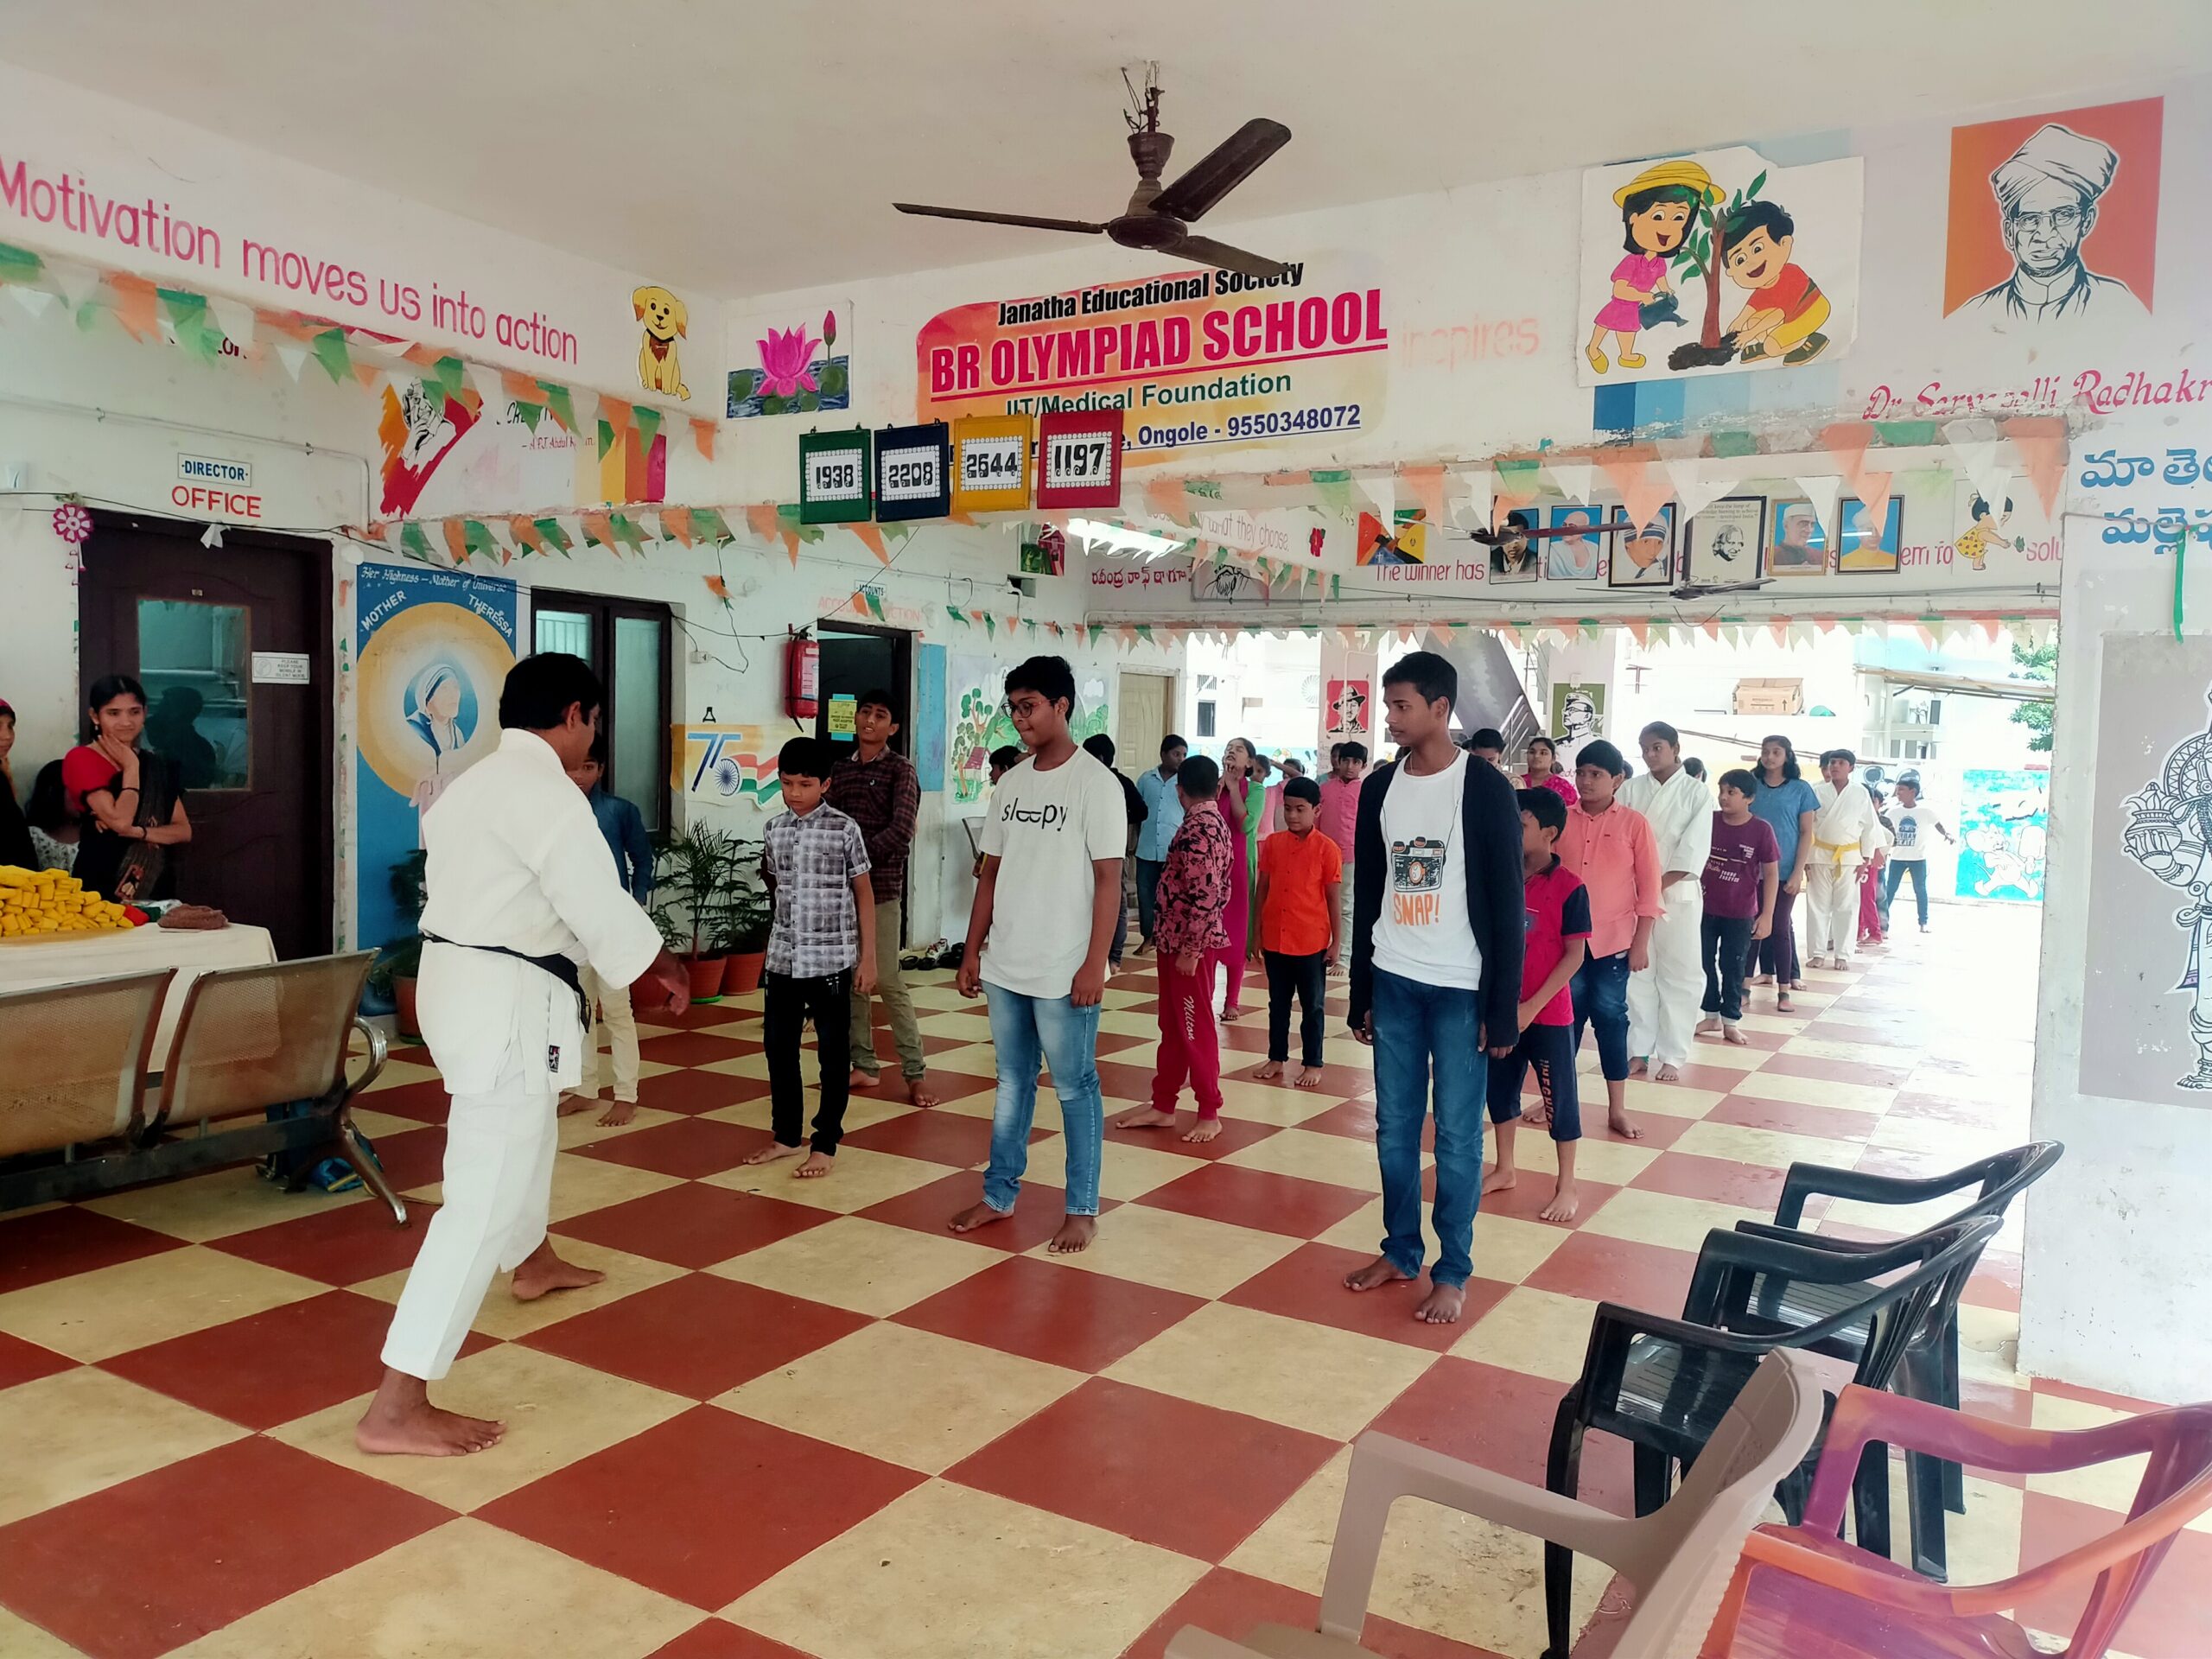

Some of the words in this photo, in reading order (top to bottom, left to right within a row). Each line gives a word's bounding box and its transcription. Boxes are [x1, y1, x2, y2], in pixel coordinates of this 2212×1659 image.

[0, 152, 221, 269] Motivation
[243, 238, 369, 307] moves
[379, 278, 422, 321] us
[432, 283, 486, 339] into
[495, 311, 578, 365] action
[997, 296, 1077, 326] Janatha
[1081, 272, 1209, 315] Educational
[931, 344, 980, 393] BR
[991, 316, 1191, 386] OLYMPIAD
[1202, 289, 1388, 361] SCHOOL
[1141, 372, 1292, 407] Foundation
[1138, 421, 1208, 448] Ongole
[1227, 404, 1361, 438] 9550348072
[184, 460, 245, 481] DIRECTOR
[888, 461, 934, 489] 2208
[1054, 442, 1106, 477] 1197
[815, 464, 855, 490] 1938
[171, 485, 262, 518] OFFICE
[361, 567, 379, 579] Her
[1404, 564, 1452, 582] winner
[1455, 559, 1484, 581] has
[360, 589, 407, 632] MOTHER
[1393, 893, 1440, 926] SNAP!
